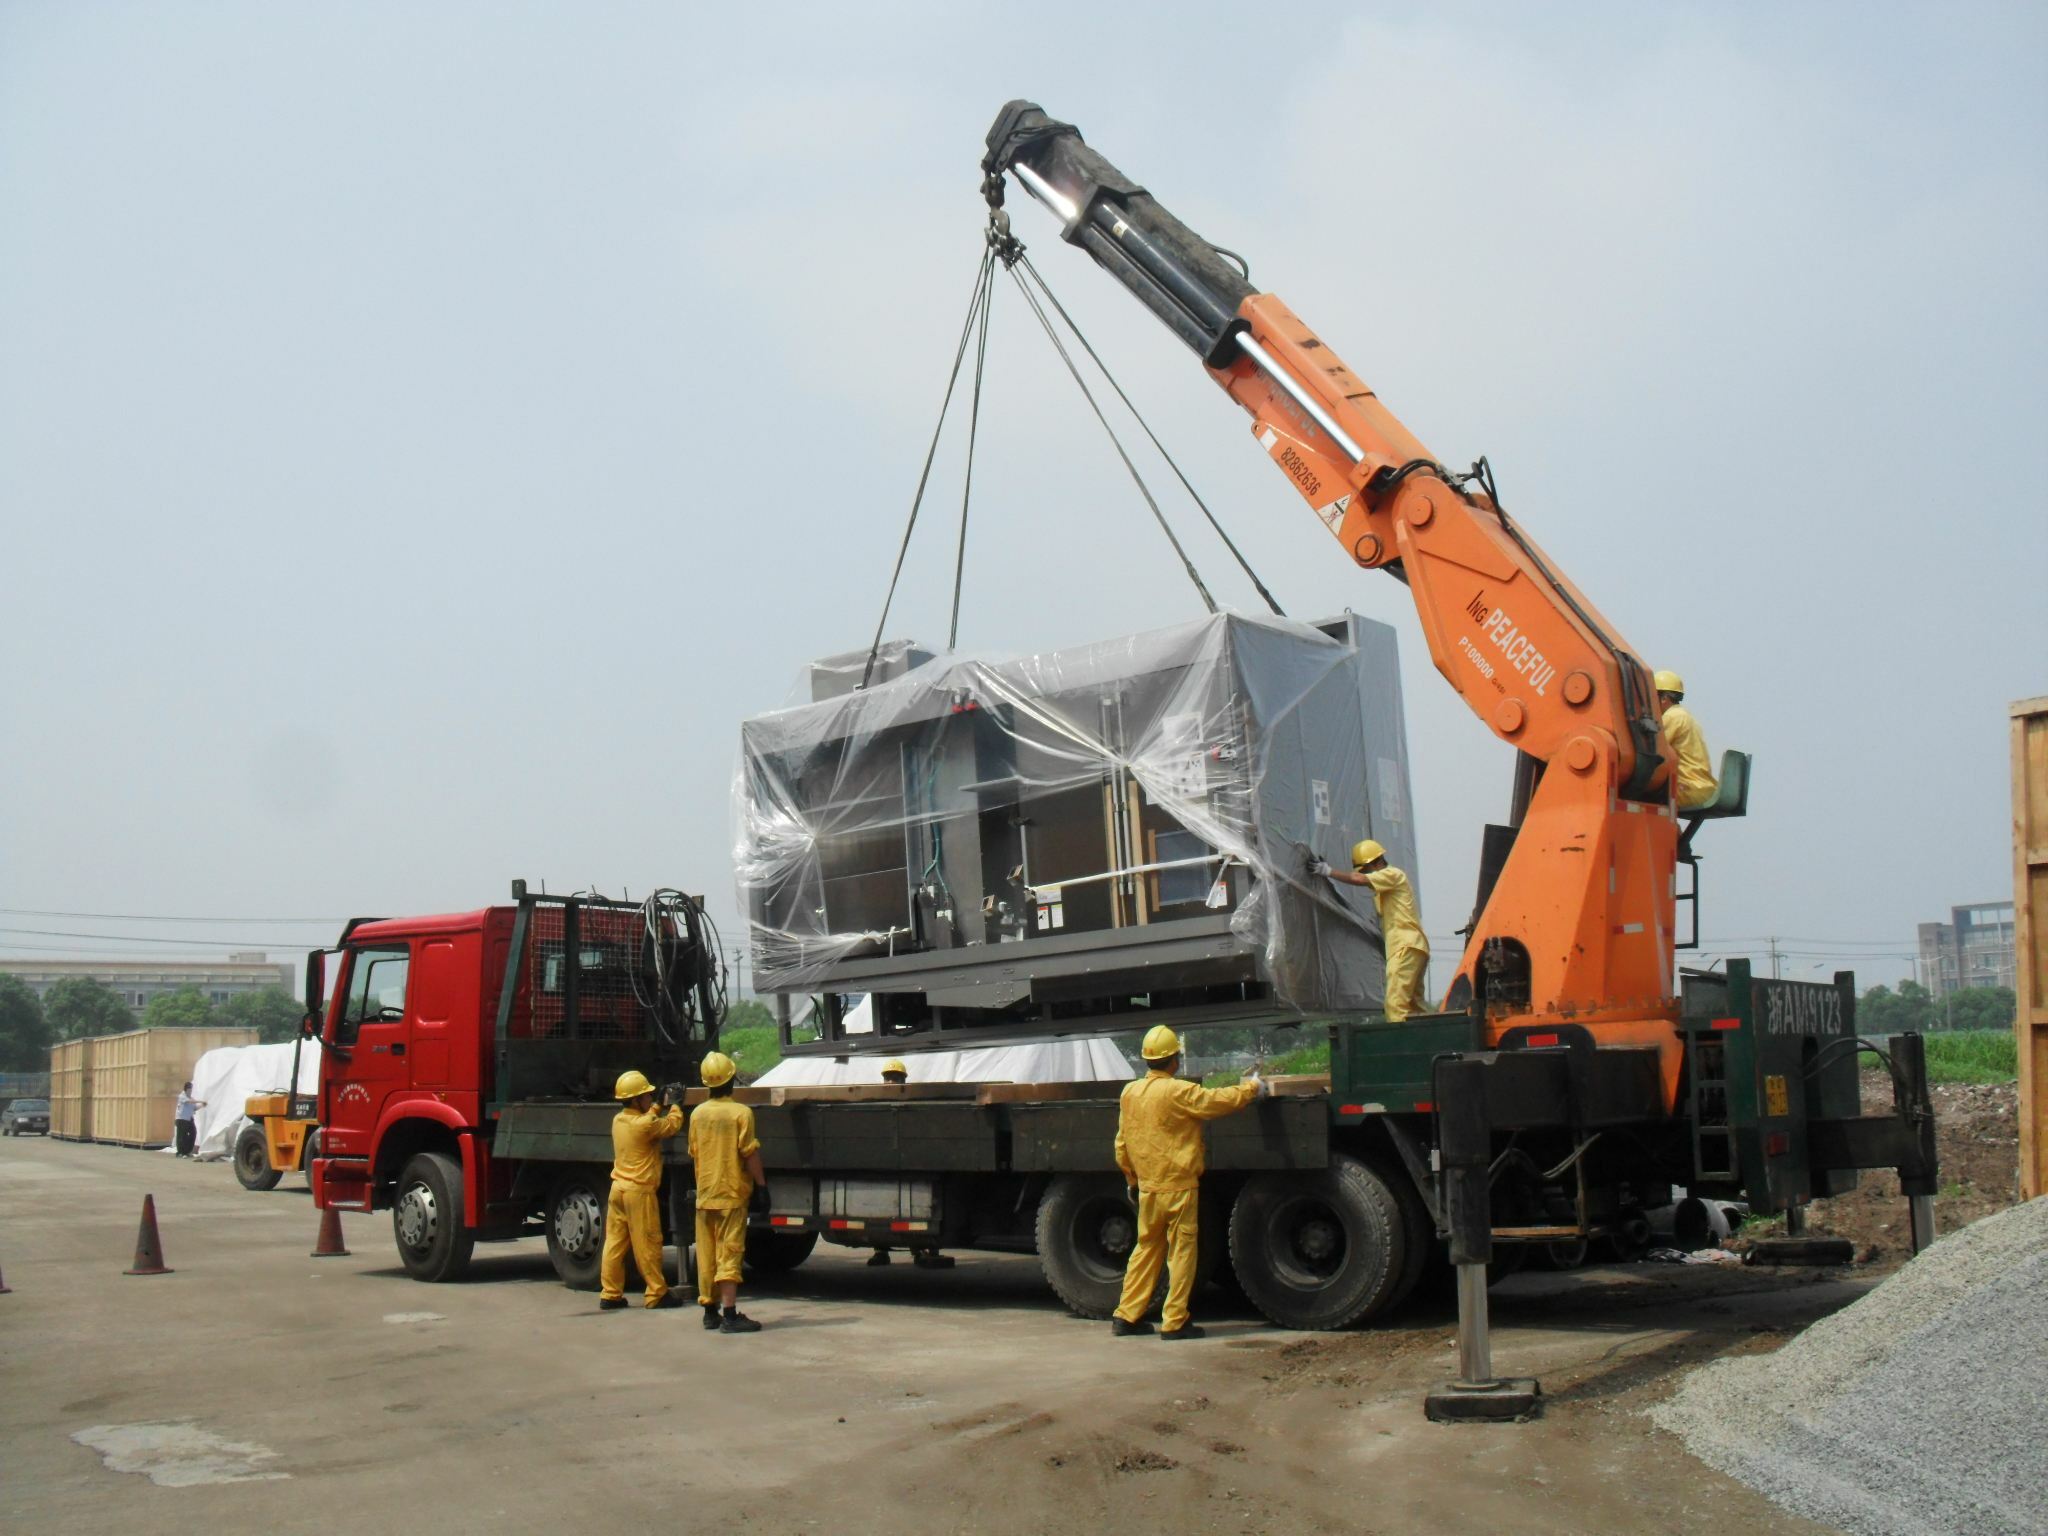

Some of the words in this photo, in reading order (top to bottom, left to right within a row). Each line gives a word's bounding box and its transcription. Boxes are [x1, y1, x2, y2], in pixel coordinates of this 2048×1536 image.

[1281, 447, 1321, 496] 82862636
[1458, 636, 1494, 678] P100000
[1482, 607, 1556, 696] PEACEFUL
